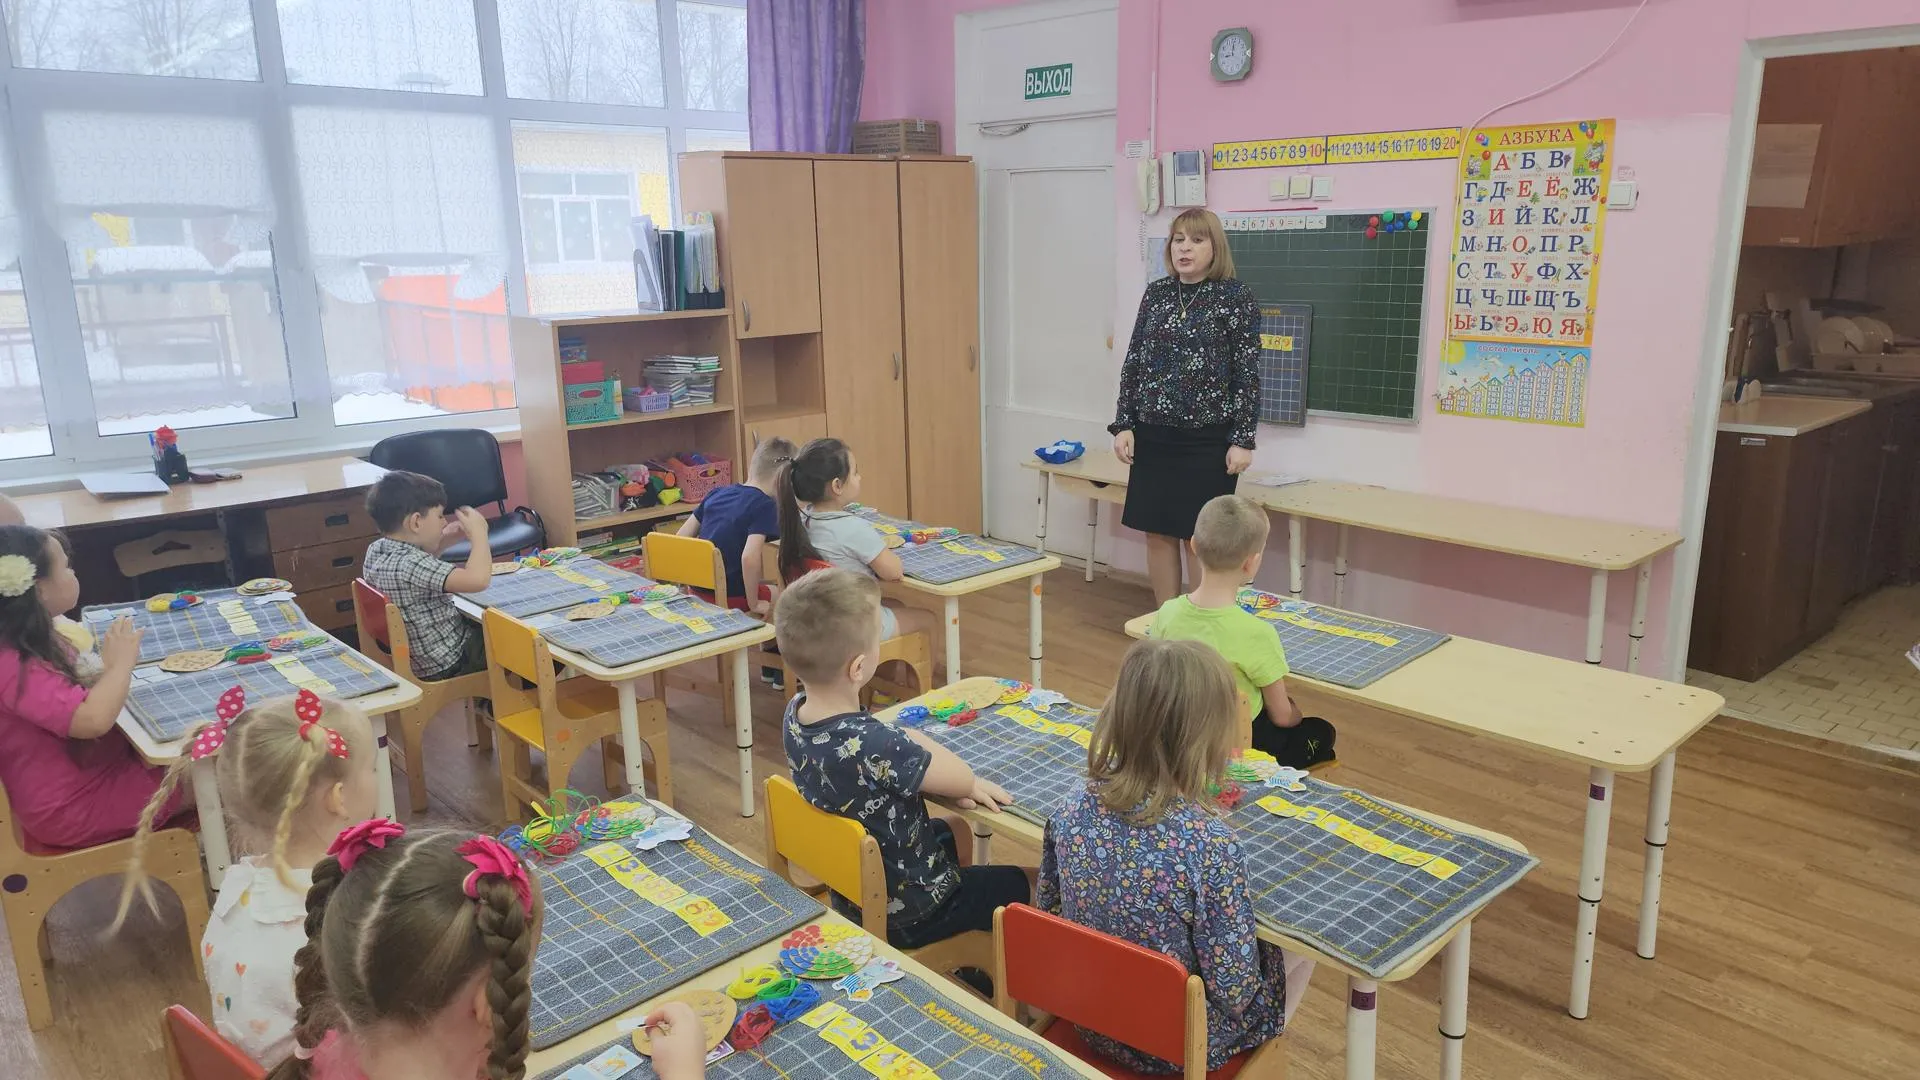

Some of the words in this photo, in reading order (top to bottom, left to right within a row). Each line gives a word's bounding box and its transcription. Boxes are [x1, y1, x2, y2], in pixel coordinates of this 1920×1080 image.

[1026, 68, 1071, 96] ВЫХОД
[1331, 143, 1339, 156] 11
[1341, 142, 1351, 156] 12
[1352, 142, 1362, 155] 13
[1365, 141, 1376, 154] 14
[1379, 140, 1388, 154] 15
[1391, 140, 1402, 153] 16
[1404, 138, 1415, 152] 17
[1417, 138, 1428, 152] 18
[1430, 137, 1441, 151] 19
[1443, 136, 1456, 150] 20
[1499, 128, 1575, 146] АЗБУКА
[1216, 150, 1223, 162] 0
[1225, 149, 1230, 163] 1
[1232, 148, 1240, 162] 2
[1242, 148, 1249, 161] 3
[1250, 147, 1258, 161] 4
[1260, 146, 1268, 160] 5
[1270, 146, 1277, 160] 6
[1280, 146, 1287, 159] 7
[1289, 144, 1296, 158] 8
[1299, 144, 1307, 158] 9
[1310, 144, 1322, 158] 10
[1493, 154, 1511, 171] А
[1520, 152, 1536, 170] Б
[1548, 150, 1564, 168] В
[1464, 182, 1478, 199] Г
[1490, 181, 1508, 202] Д
[1516, 180, 1533, 198] Е
[1544, 176, 1561, 197] Ё
[1572, 178, 1596, 196] Ж
[1462, 210, 1475, 226] З
[1488, 208, 1506, 226] И
[1514, 205, 1532, 225] Й
[1542, 207, 1559, 225] К
[1570, 206, 1590, 224] Л
[1460, 236, 1477, 252] М
[1486, 236, 1504, 252] Н
[1512, 236, 1528, 253] О
[1539, 236, 1559, 252] П
[1568, 235, 1584, 252] Р
[1456, 262, 1470, 279] С
[1484, 262, 1498, 279] Т
[1511, 262, 1527, 280] У
[1536, 263, 1557, 280] Ф
[1565, 263, 1584, 280] Х
[1455, 288, 1472, 308] Ц
[1481, 289, 1497, 305] Ч
[1506, 290, 1527, 306] Ш
[1533, 290, 1556, 311] Щ
[1562, 291, 1581, 308] Ъ
[1454, 314, 1472, 330] Ы
[1480, 316, 1493, 331] Ь
[1504, 316, 1518, 332] Э
[1532, 317, 1552, 334] Ю
[1560, 318, 1577, 336] Я
[858, 794, 890, 820] BOOM
[616, 860, 639, 874] 3
[685, 900, 710, 915] 8
[830, 1018, 858, 1039] 2
[851, 1031, 880, 1052] 3
